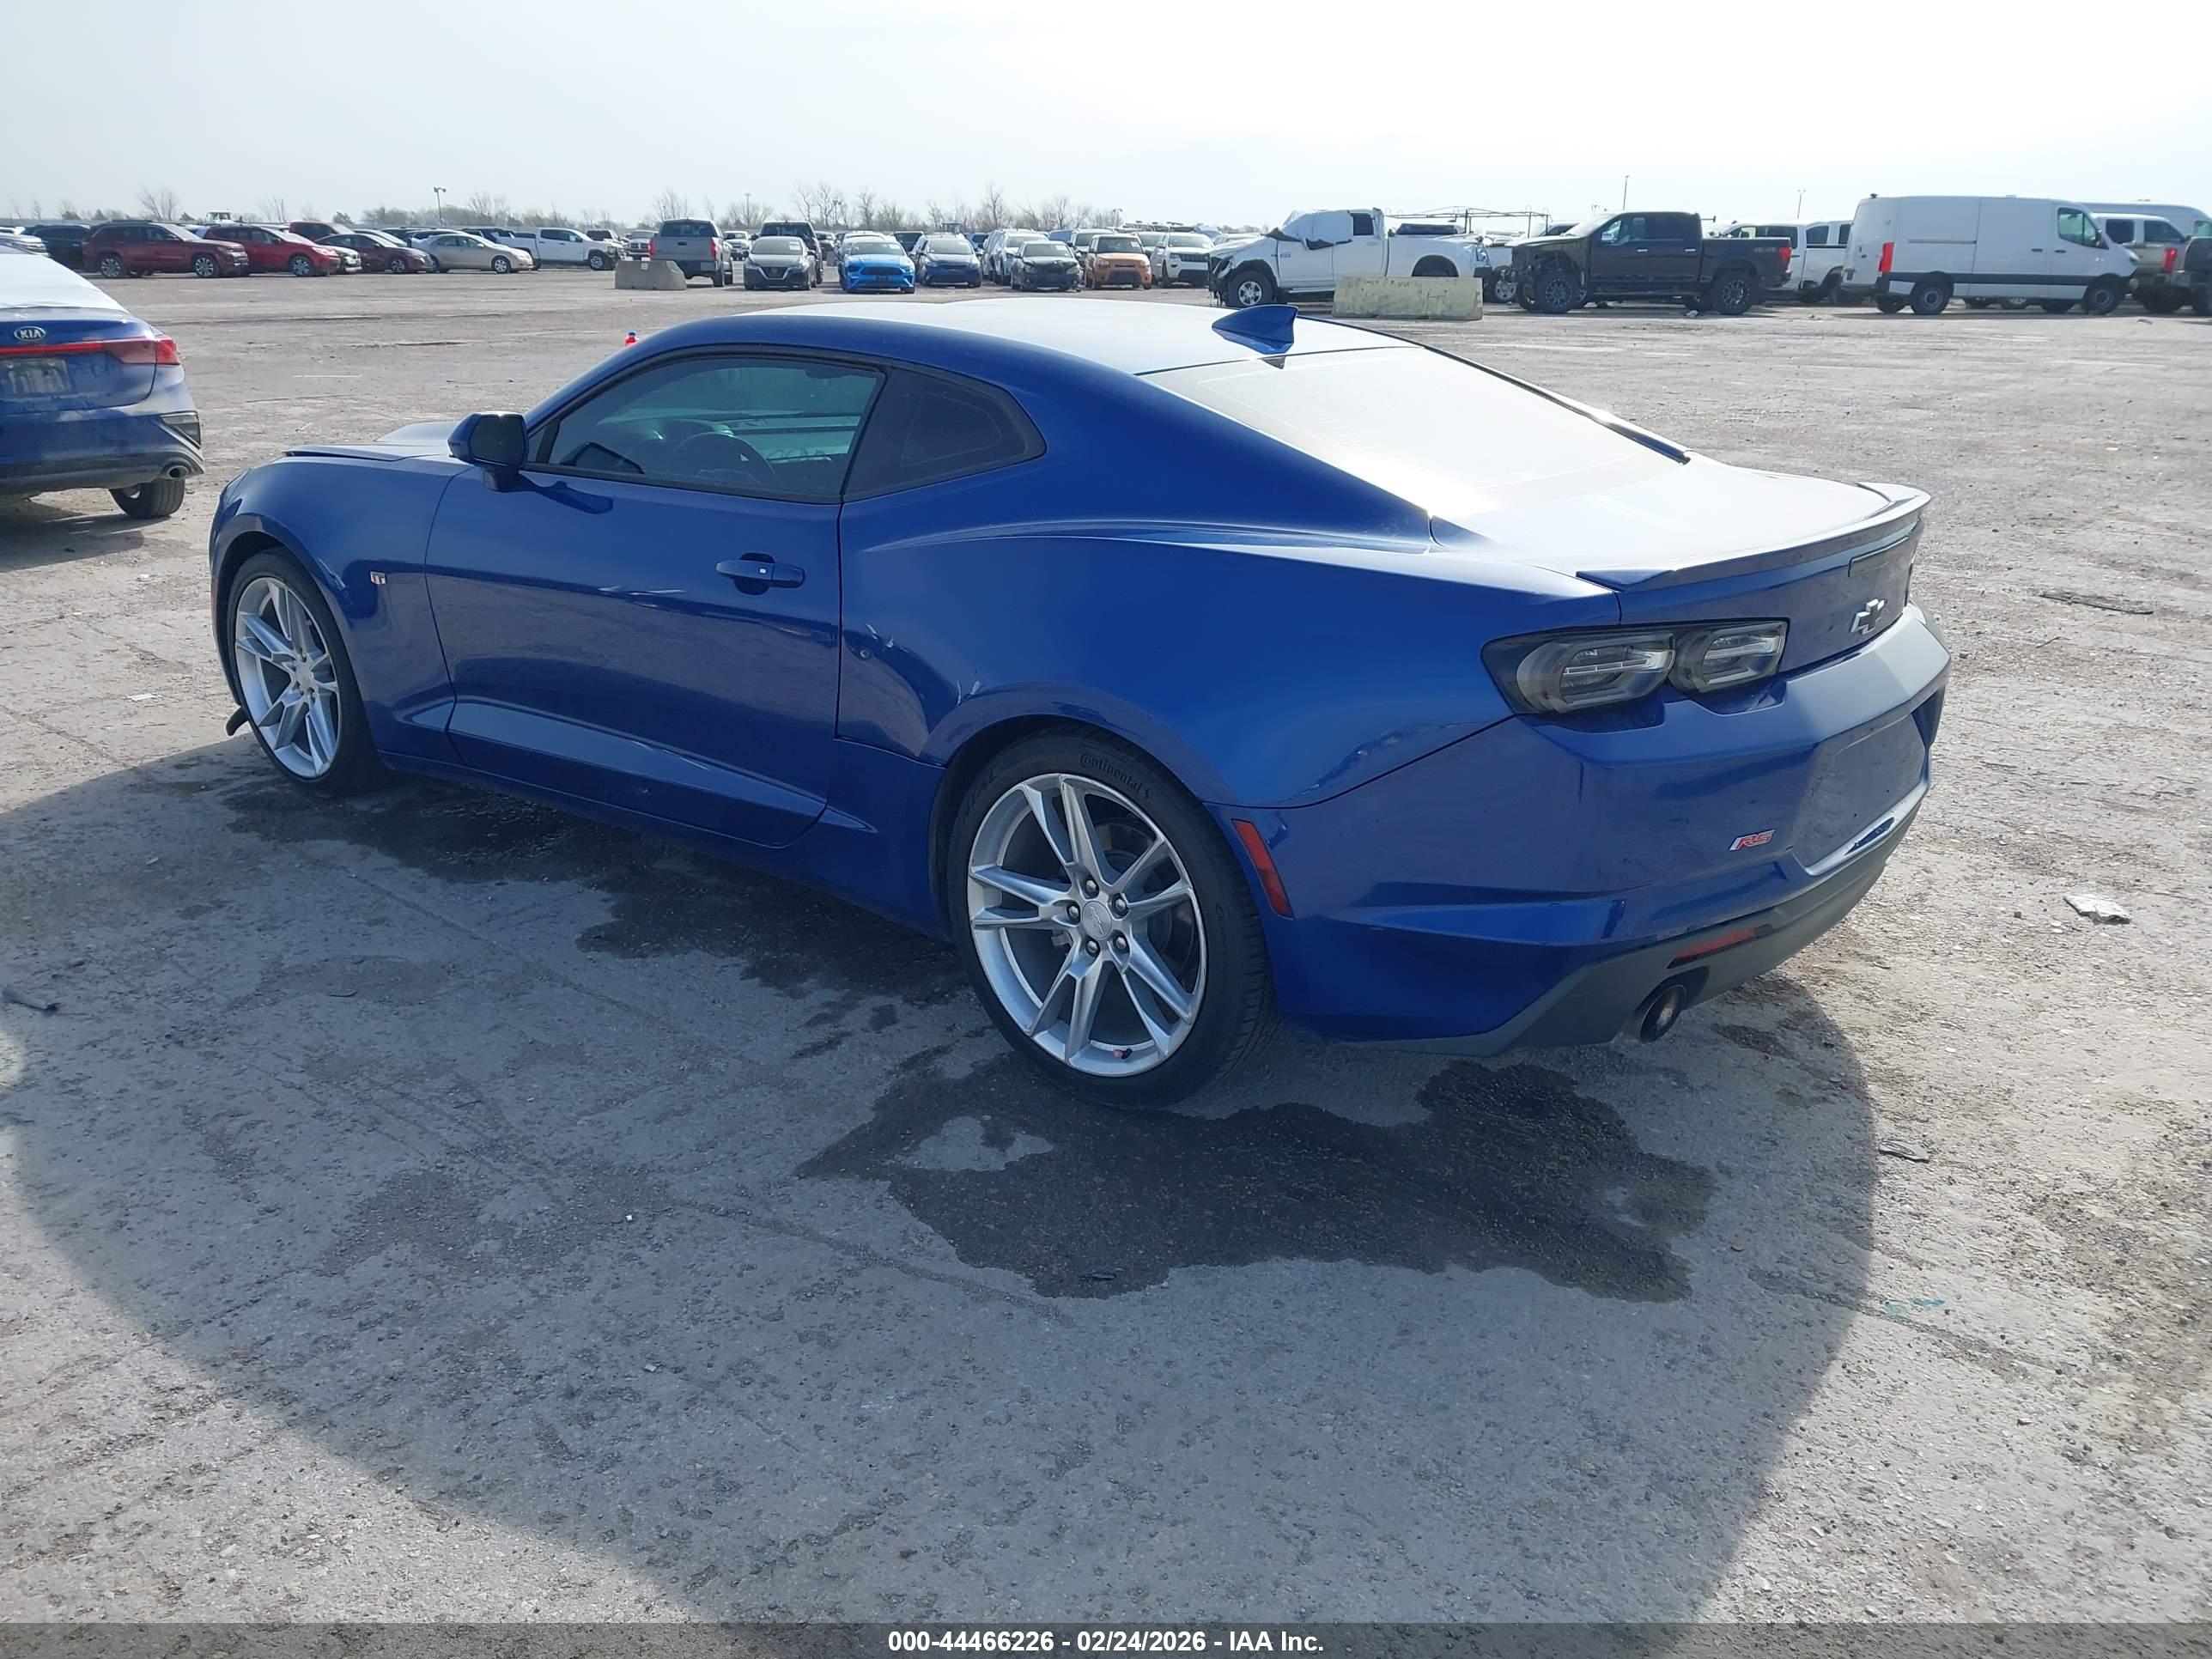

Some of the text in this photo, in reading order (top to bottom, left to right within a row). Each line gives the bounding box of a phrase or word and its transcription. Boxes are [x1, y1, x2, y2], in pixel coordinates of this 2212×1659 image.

[19, 328, 42, 338] KIA
[1079, 751, 1143, 794] Continental
[1730, 830, 1774, 851] RS
